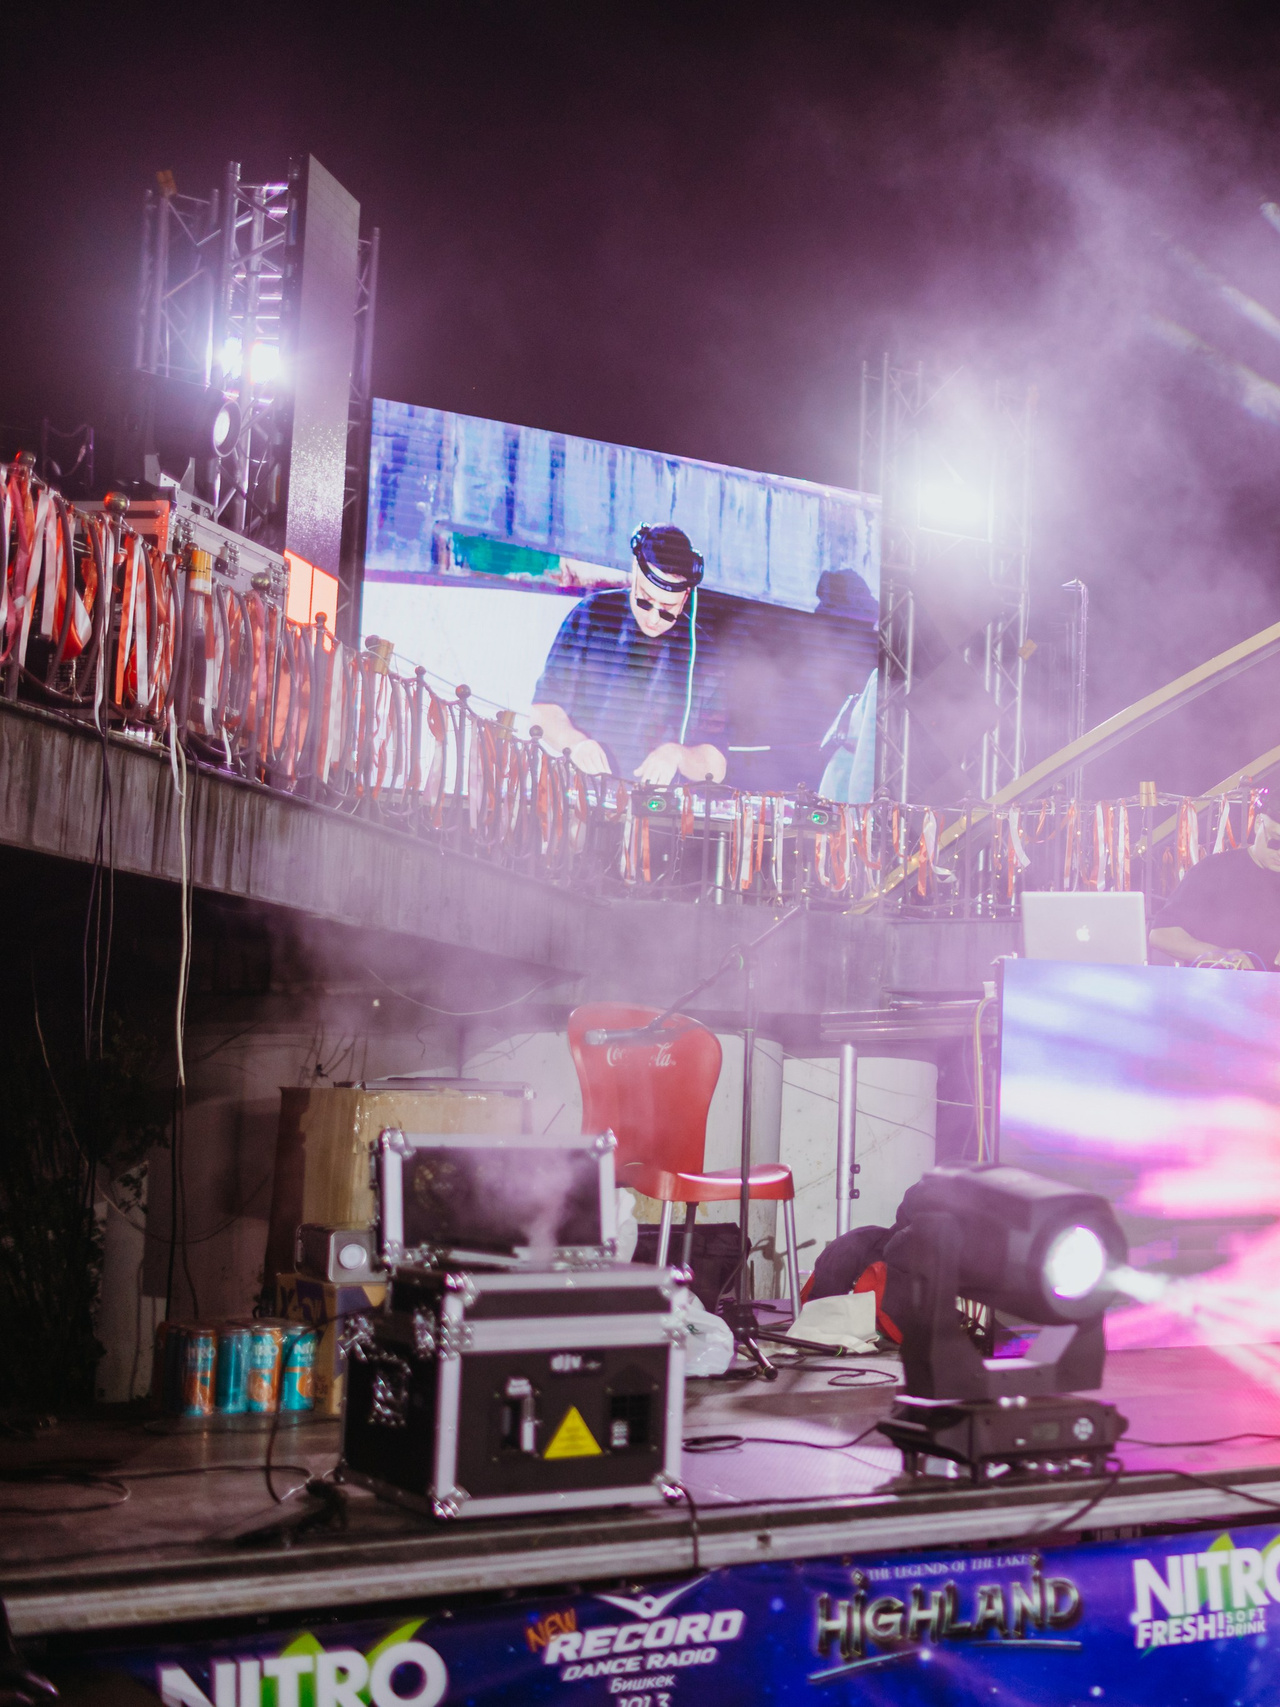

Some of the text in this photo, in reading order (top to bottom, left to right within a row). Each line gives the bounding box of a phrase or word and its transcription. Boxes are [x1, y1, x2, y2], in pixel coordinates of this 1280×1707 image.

[868, 1568, 892, 1581] THE
[895, 1562, 949, 1579] LEGENDS
[951, 1560, 967, 1573] OF
[971, 1557, 994, 1570] THE
[526, 1609, 577, 1653] NEW
[817, 1575, 1081, 1662] HIGHLAND
[1136, 1610, 1226, 1649] FRESH!
[1226, 1607, 1265, 1622] SOFT
[1226, 1621, 1266, 1637] DRINK
[545, 1609, 745, 1665] RECORD
[562, 1647, 718, 1682] DANCE RADIO
[610, 1674, 676, 1694] Бишкек
